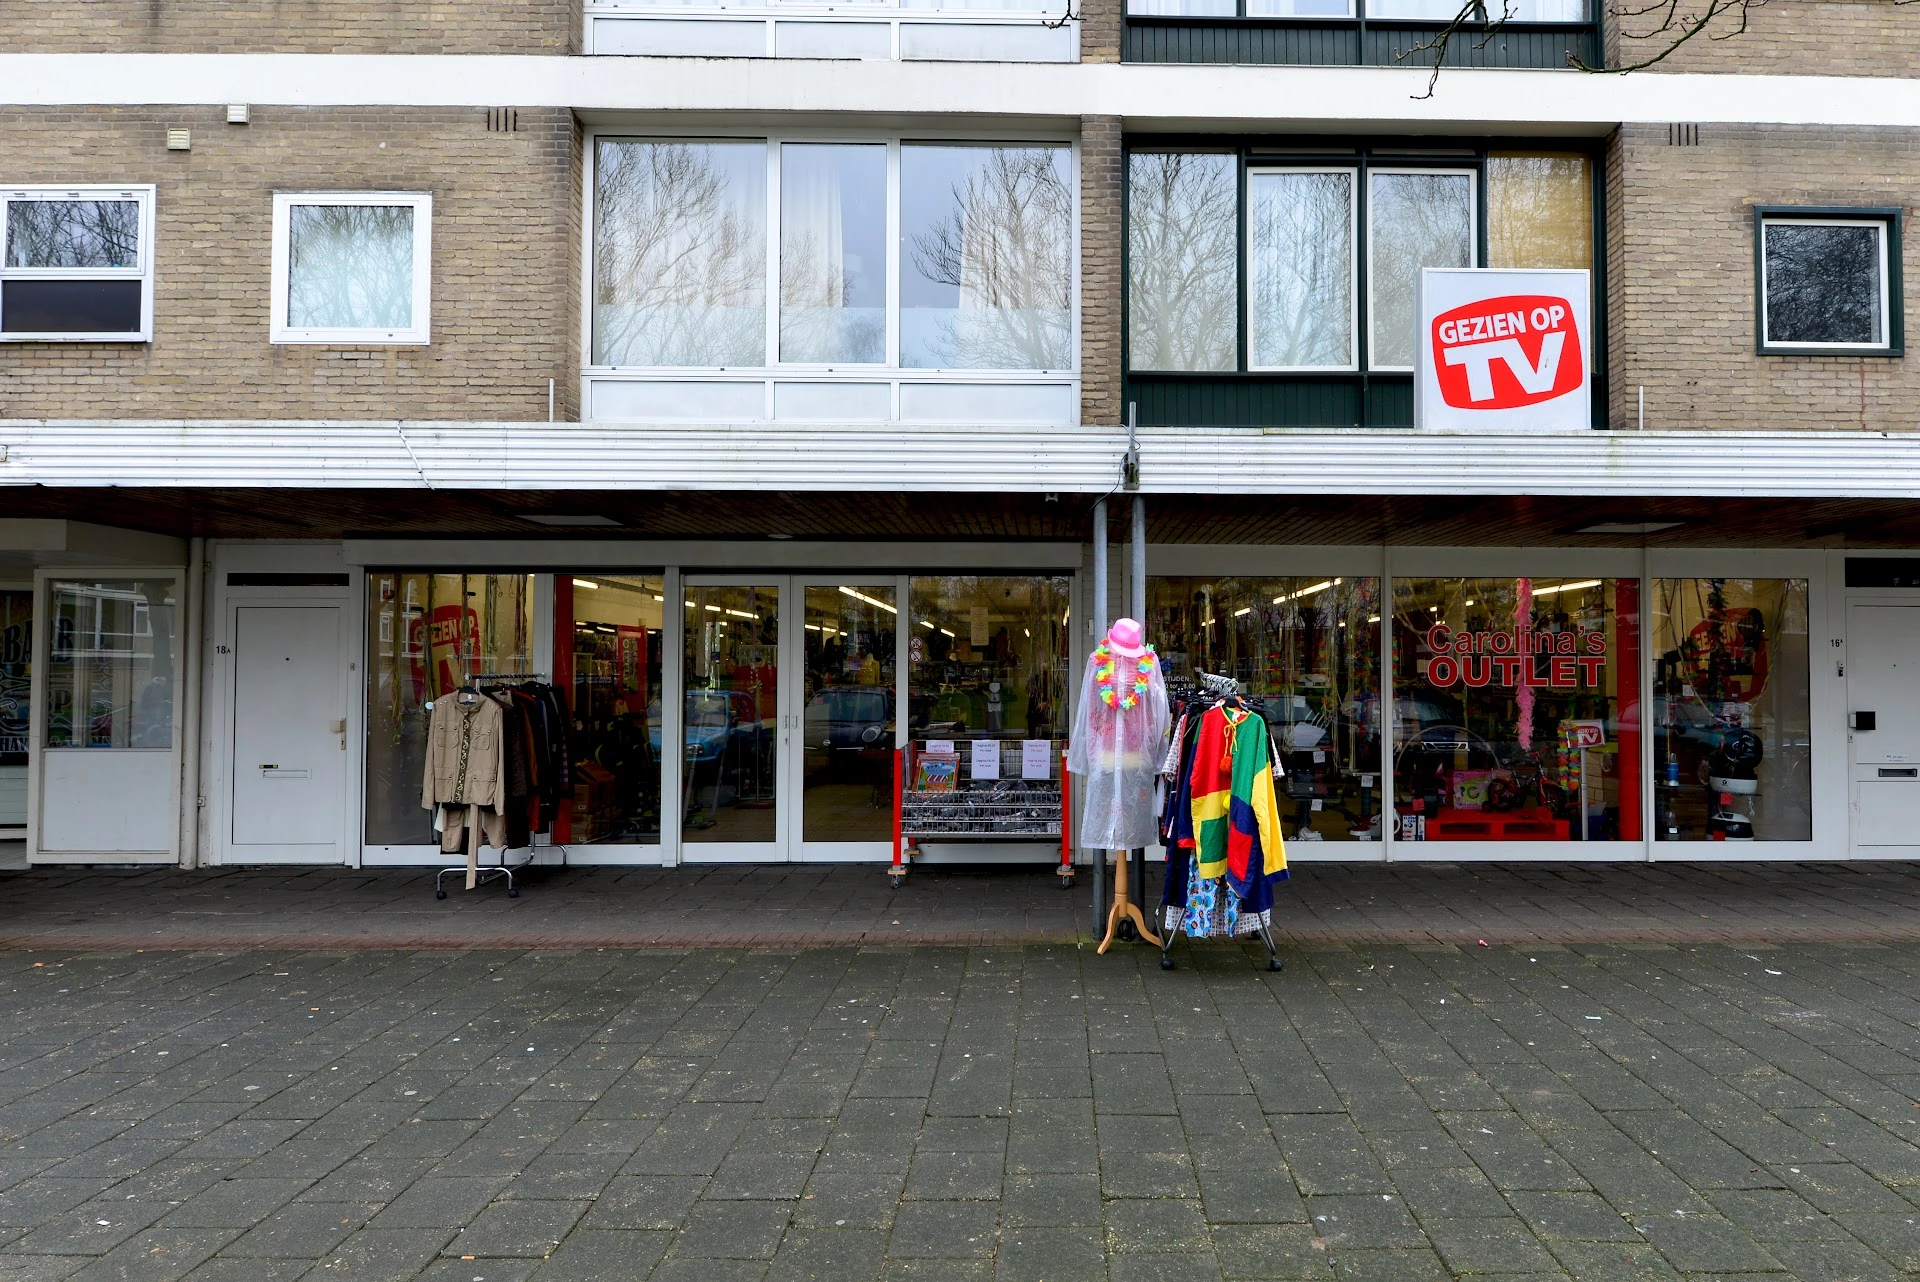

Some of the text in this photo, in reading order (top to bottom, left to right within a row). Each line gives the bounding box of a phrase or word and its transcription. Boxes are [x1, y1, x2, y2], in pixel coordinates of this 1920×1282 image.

[1439, 305, 1565, 344] GEZIEN OP
[1443, 330, 1566, 402] TV
[1427, 624, 1607, 654] Carolina's
[1427, 655, 1607, 688] OUTLET
